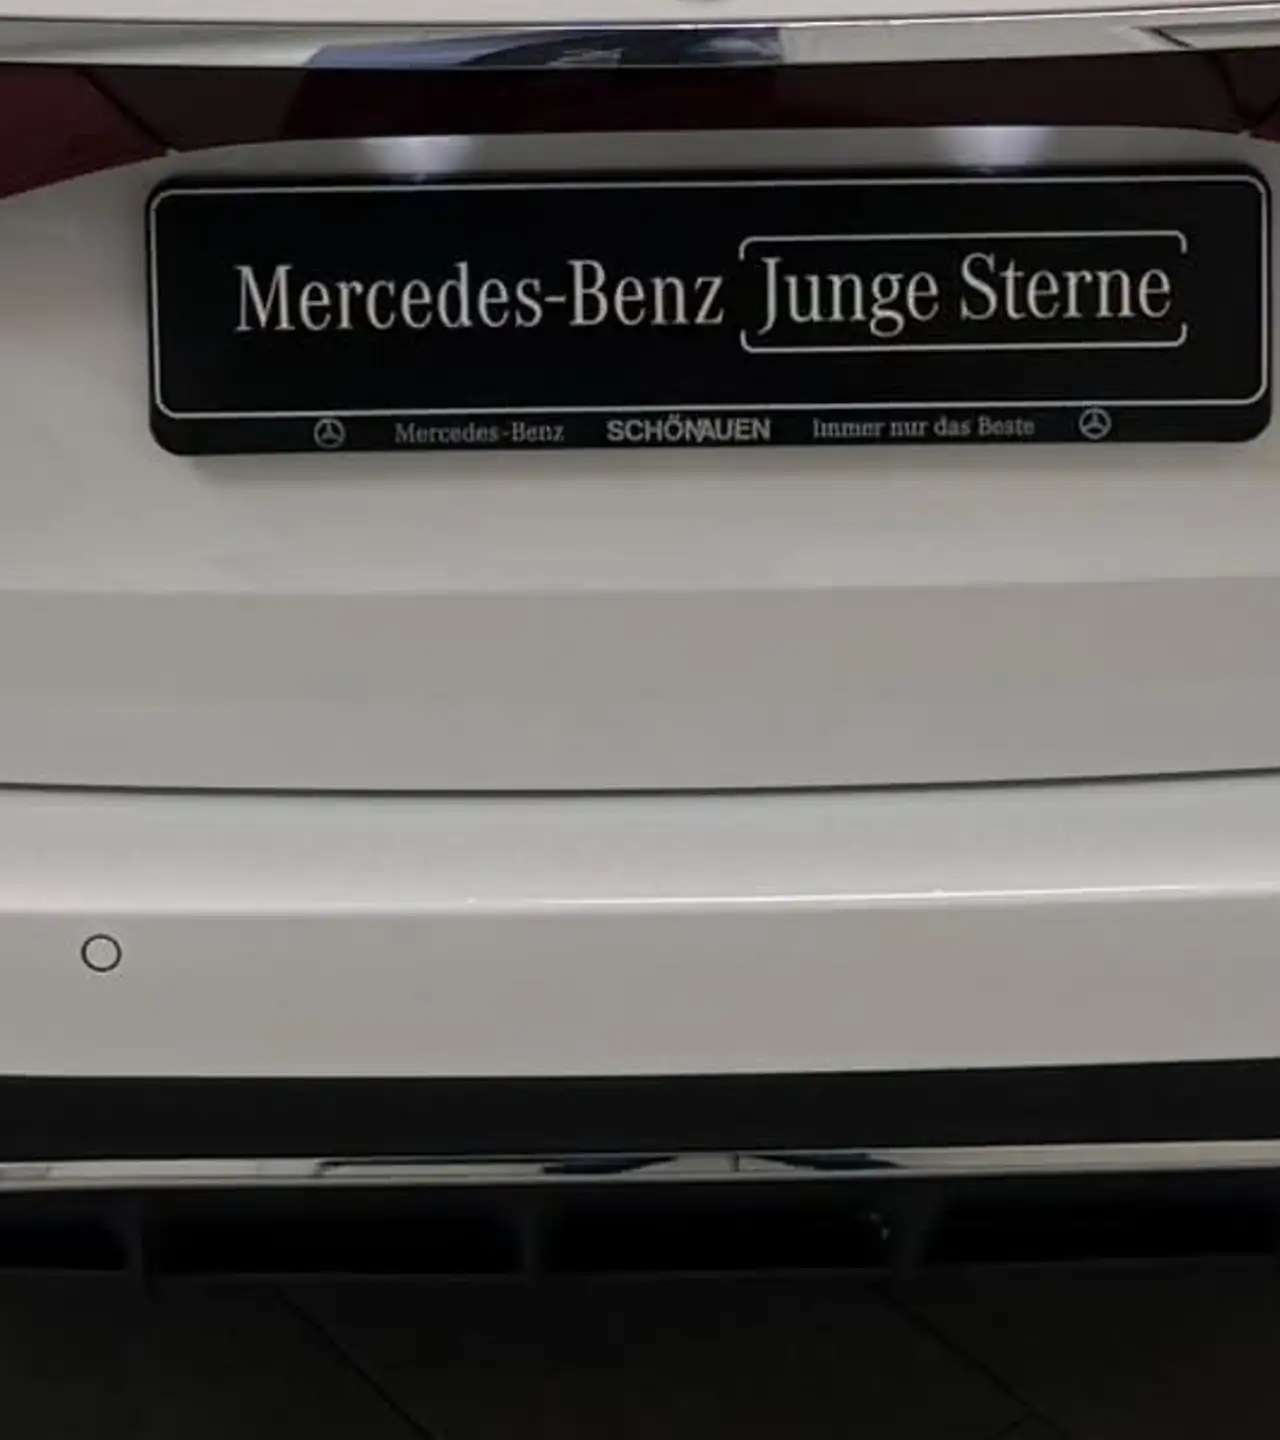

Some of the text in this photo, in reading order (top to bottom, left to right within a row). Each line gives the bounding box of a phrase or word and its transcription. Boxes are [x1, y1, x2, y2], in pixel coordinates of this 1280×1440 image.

[233, 252, 1172, 338] Mercedes-Benz Junge Sterne
[394, 413, 1036, 444] Mercedes-Benz SCHÖNAUEN Immer nur das Beste
